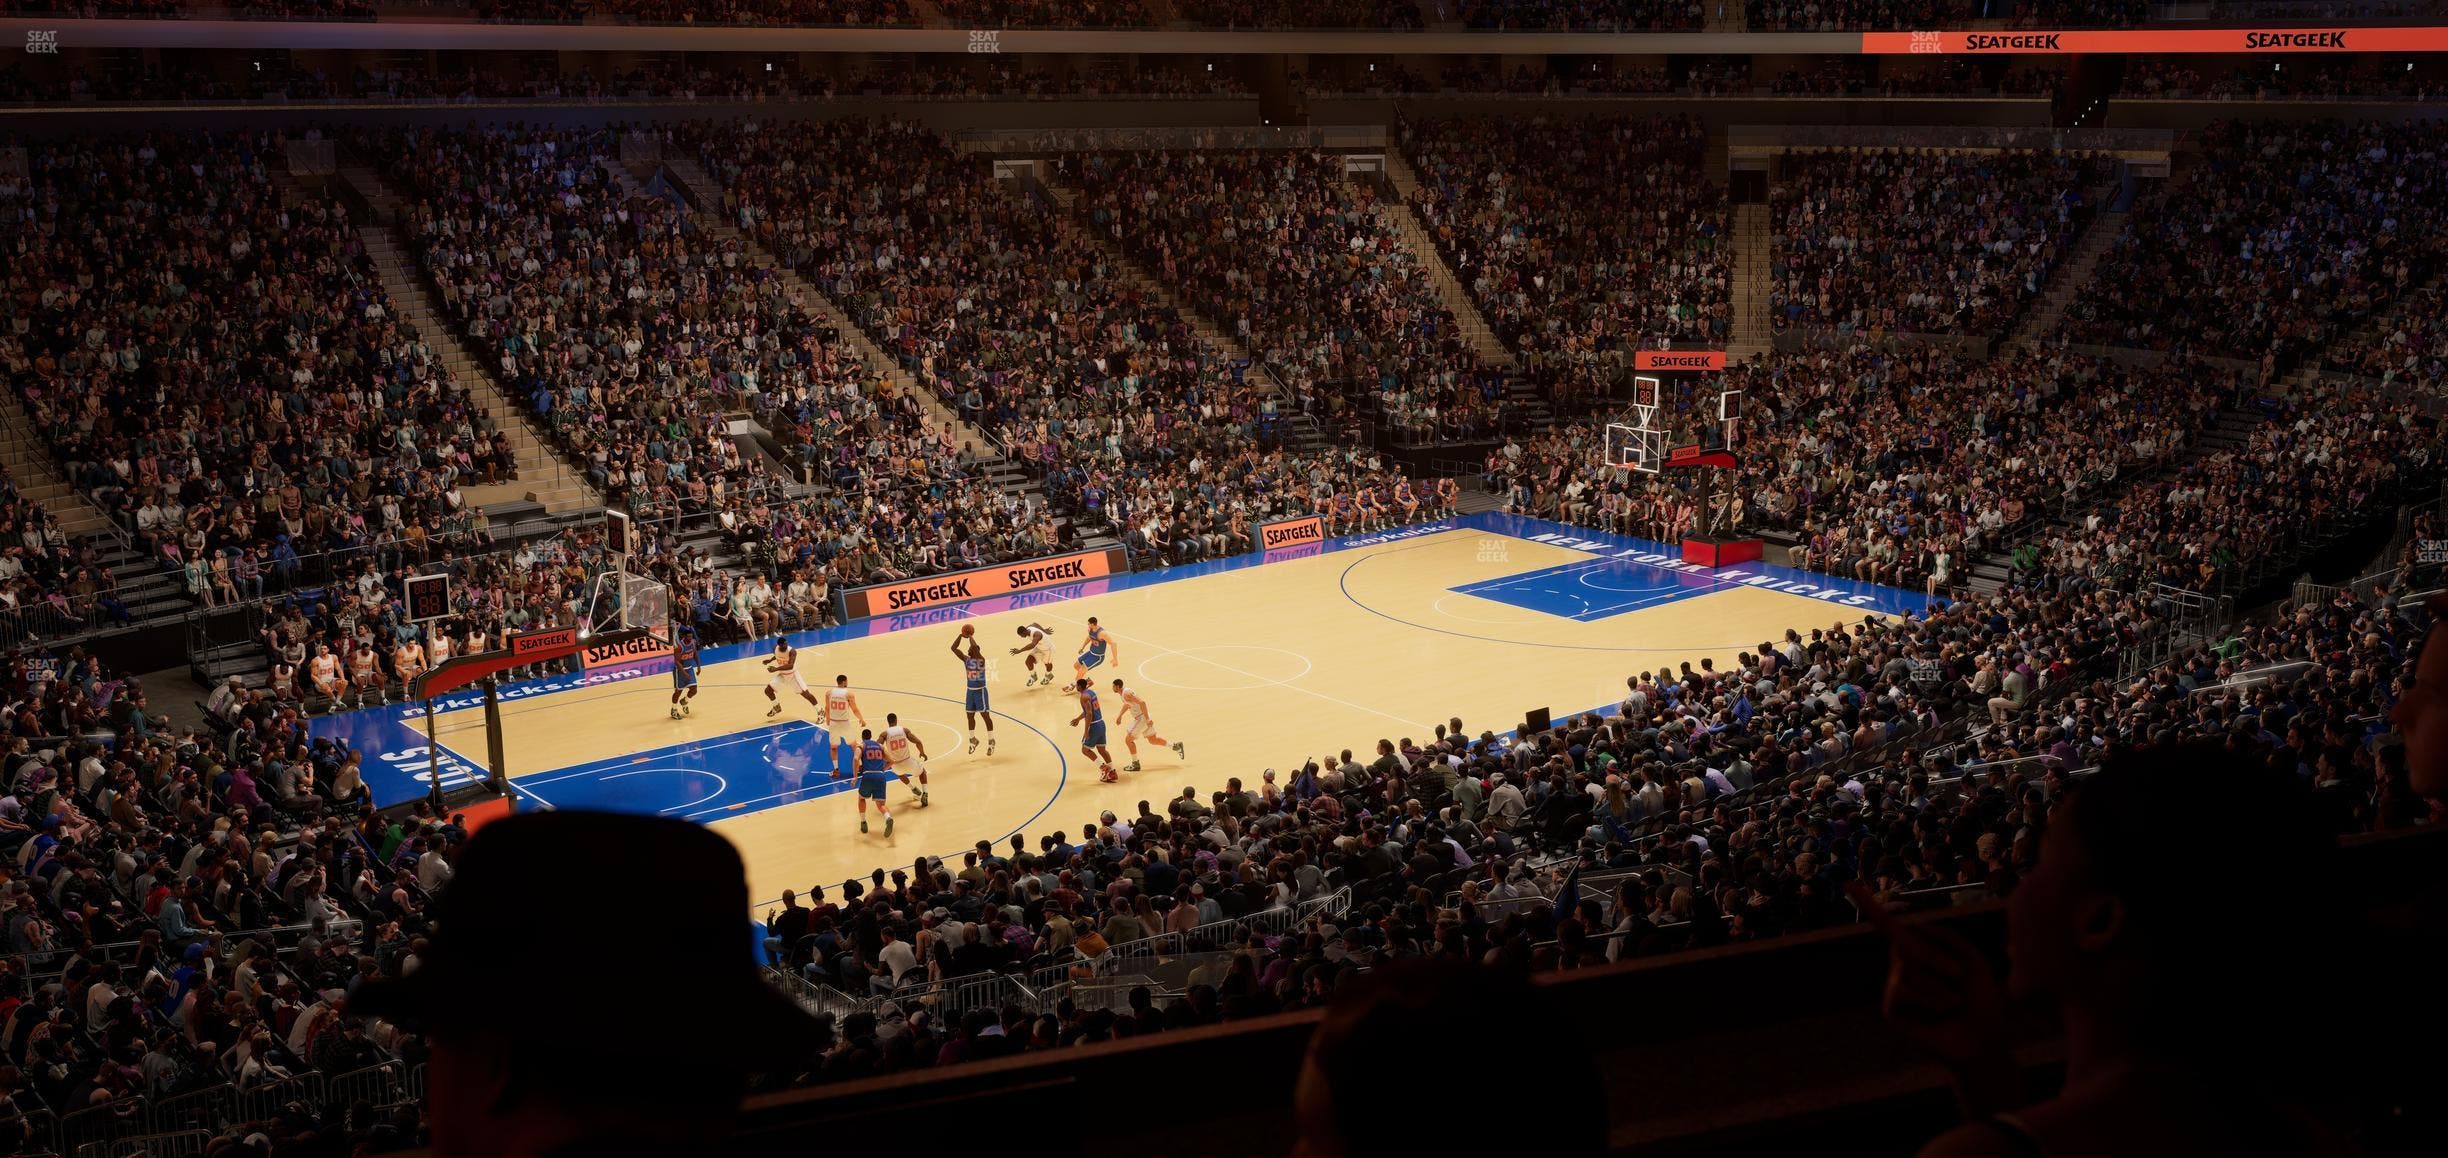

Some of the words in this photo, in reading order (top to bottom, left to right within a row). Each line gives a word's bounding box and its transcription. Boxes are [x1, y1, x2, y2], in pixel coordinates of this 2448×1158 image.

[1966, 34, 2061, 50] SEATGEEK
[2245, 31, 2346, 49] SEATGEEK
[1650, 356, 1711, 368] SEATGEEK
[1266, 522, 1320, 546] SEATGEEK
[1343, 525, 1453, 547] @nyknicks
[1009, 559, 1086, 589] SEATGEEK
[1526, 532, 1615, 552] NEW
[1712, 569, 1876, 606] KNICKS
[888, 578, 972, 610] SEATGEEK
[520, 632, 570, 651] SEATGEEK
[831, 701, 846, 710] 00
[890, 738, 906, 751] 00
[866, 750, 882, 760] 00
